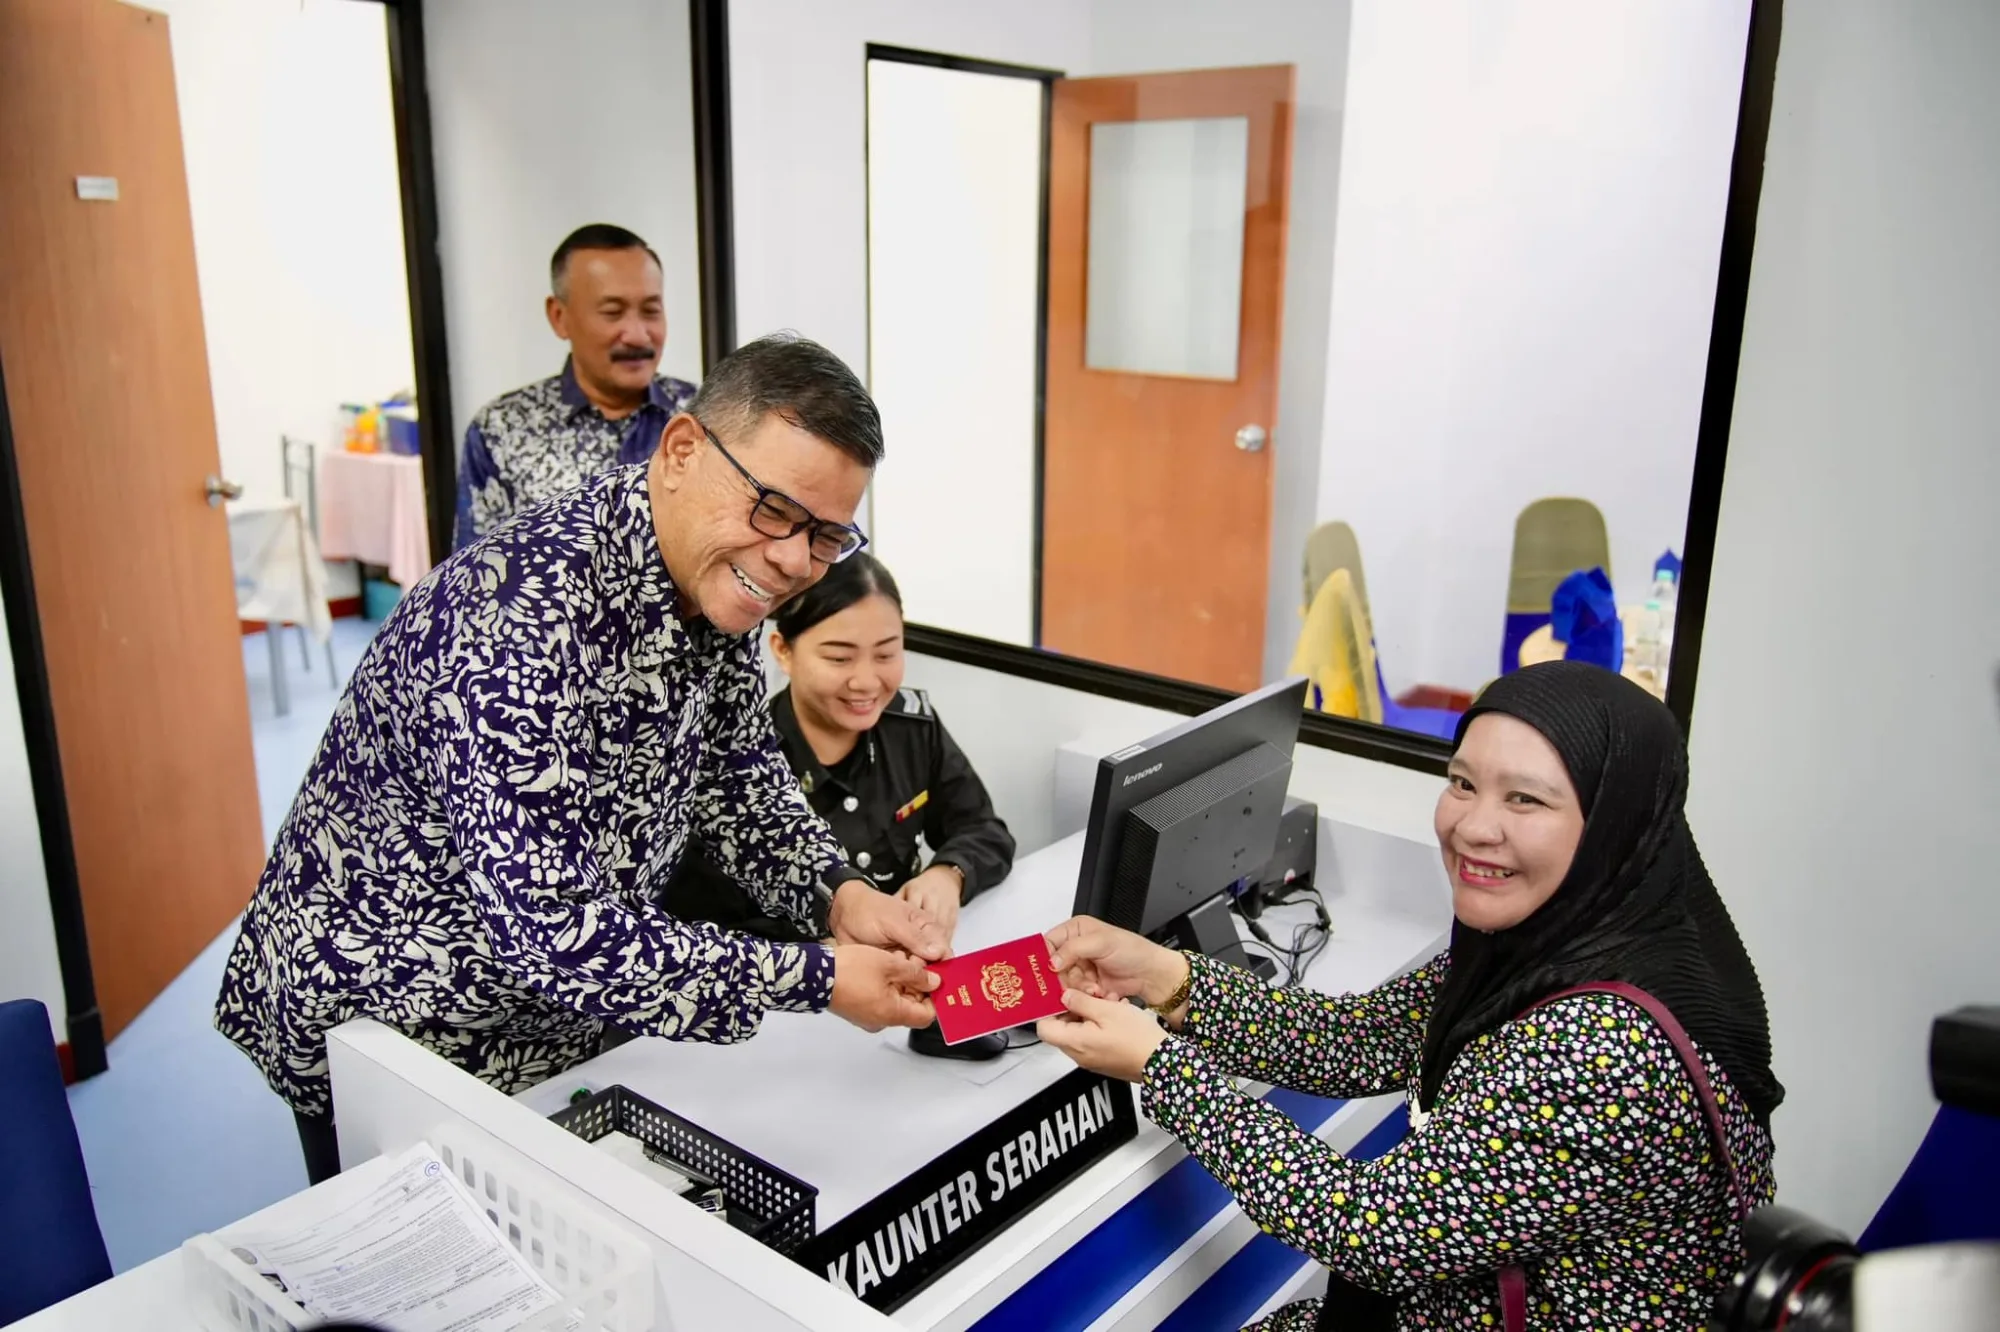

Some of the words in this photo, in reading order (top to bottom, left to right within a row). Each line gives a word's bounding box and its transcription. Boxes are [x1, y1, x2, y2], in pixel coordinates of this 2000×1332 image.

[1122, 762, 1163, 787] lenovo
[1027, 954, 1049, 997] MALAYSIA
[826, 1170, 983, 1299] KAUNTER
[985, 1079, 1115, 1202] SERAHAN
